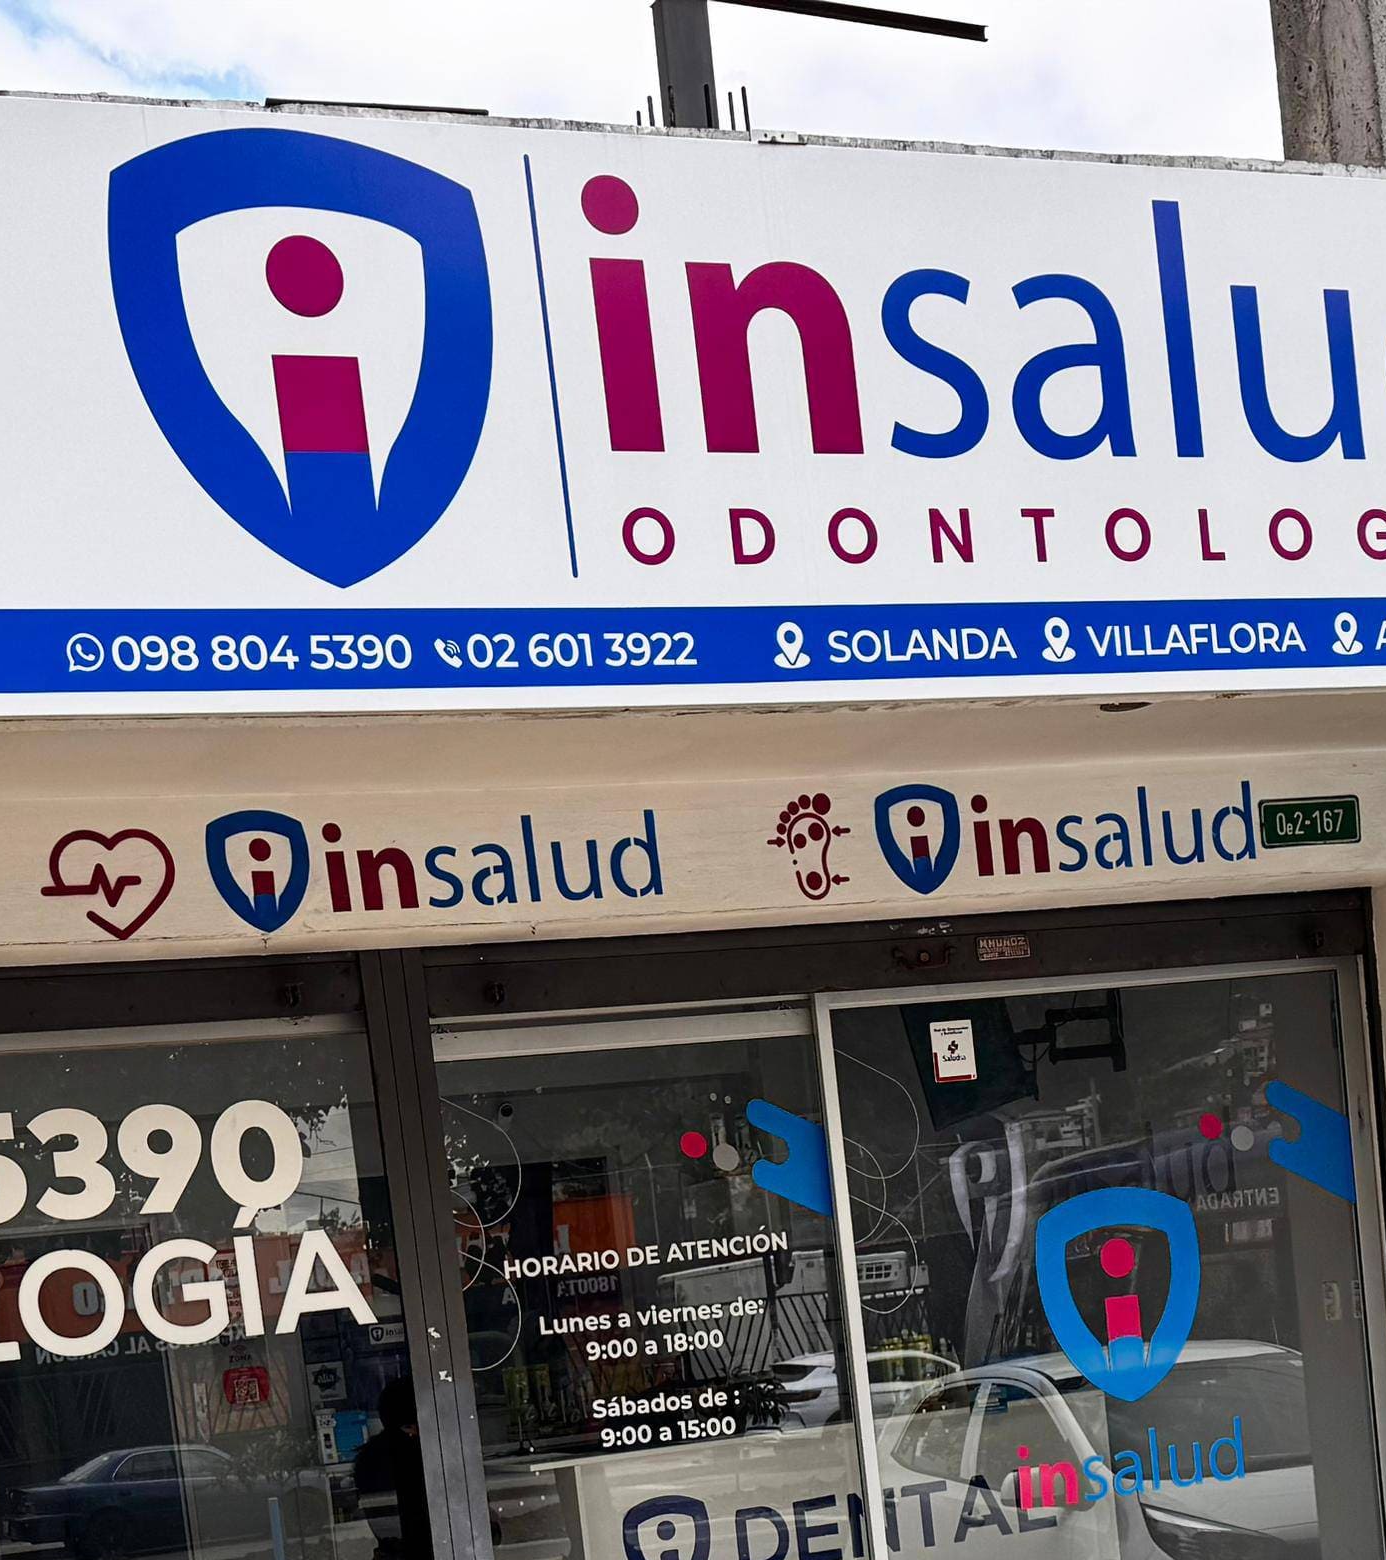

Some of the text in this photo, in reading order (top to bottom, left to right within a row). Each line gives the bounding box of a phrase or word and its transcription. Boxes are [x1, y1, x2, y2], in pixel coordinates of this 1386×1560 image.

[113, 631, 698, 672] 098 804 5390 02 601 3922
[827, 626, 1017, 663] SOLANDA
[1087, 620, 1306, 658] VILLAFLORA
[970, 780, 1259, 877] insalud
[321, 809, 665, 913] insalud
[503, 1226, 789, 1280] HORARIO DE ATENCIÓN
[539, 1296, 765, 1336] Lunes a viernes de:
[586, 1328, 725, 1362] 9:00 a 18:00
[592, 1395, 693, 1419] Sábados
[698, 1387, 728, 1409] de
[600, 1416, 737, 1448] 9:00 a 15:00
[1016, 1416, 1246, 1512] insalud
